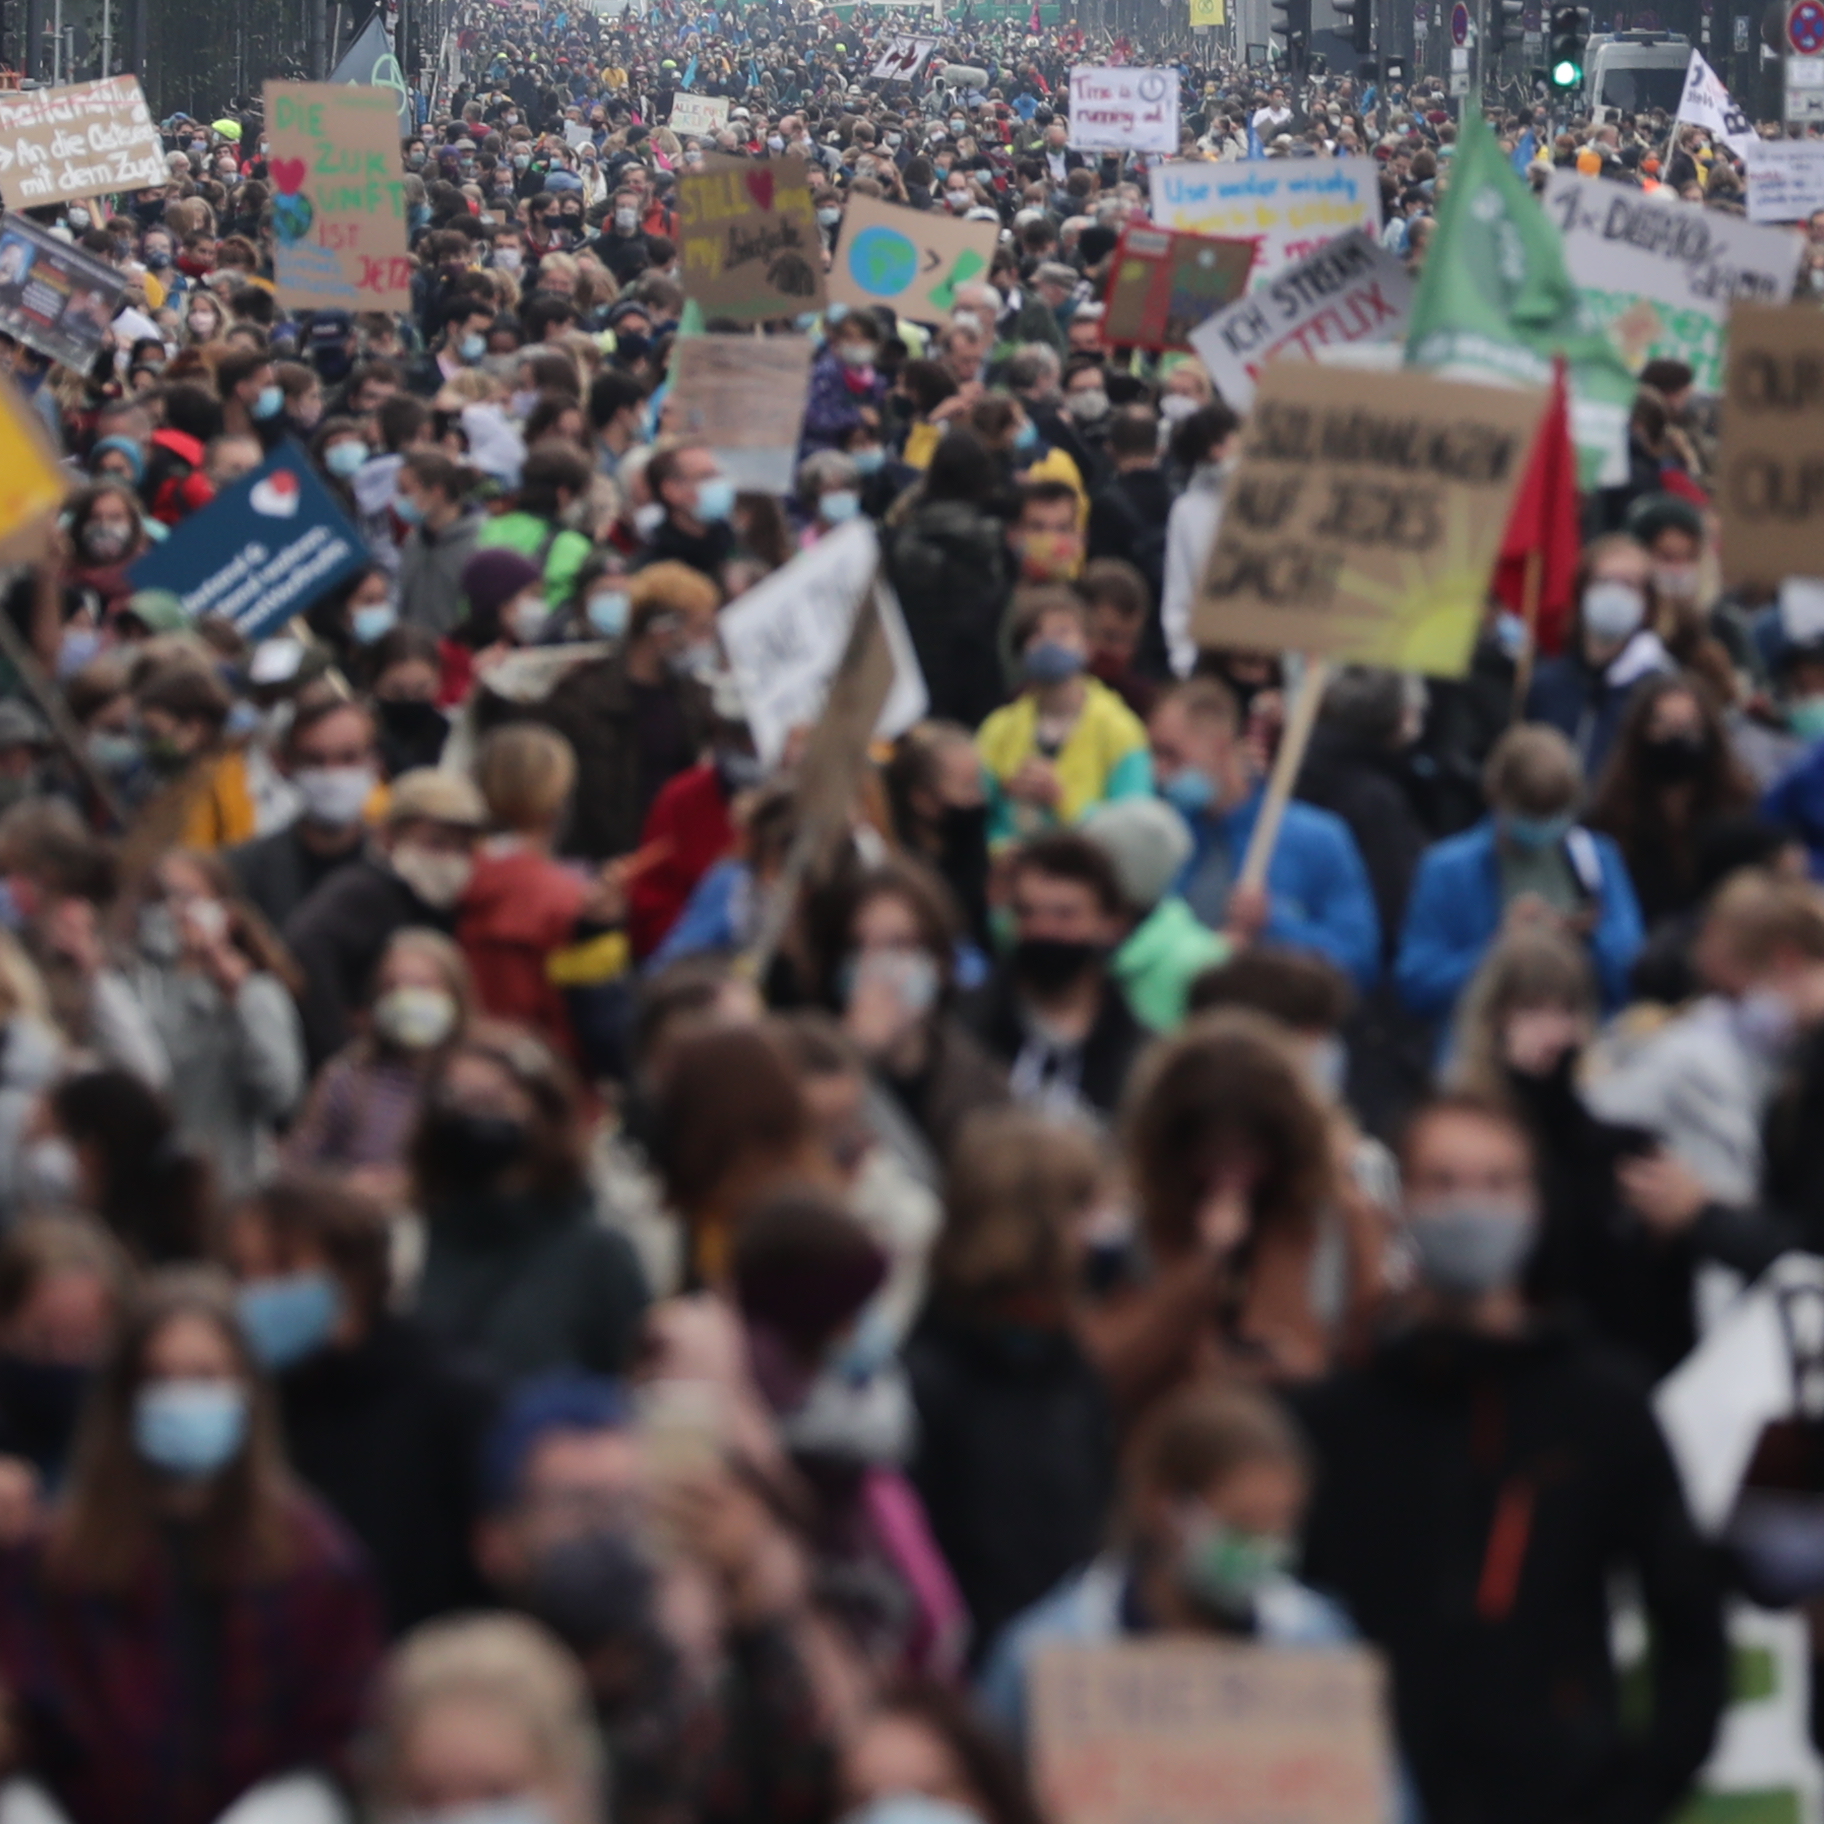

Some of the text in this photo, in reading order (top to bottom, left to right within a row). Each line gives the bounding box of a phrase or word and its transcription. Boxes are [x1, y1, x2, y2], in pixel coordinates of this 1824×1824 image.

[16, 137, 47, 167] An
[51, 129, 87, 159] die
[19, 164, 55, 197] mit
[58, 160, 113, 191] dem
[1164, 175, 1209, 204] Use
[1217, 301, 1275, 357] ICH
[1244, 281, 1400, 382] TFLIX
